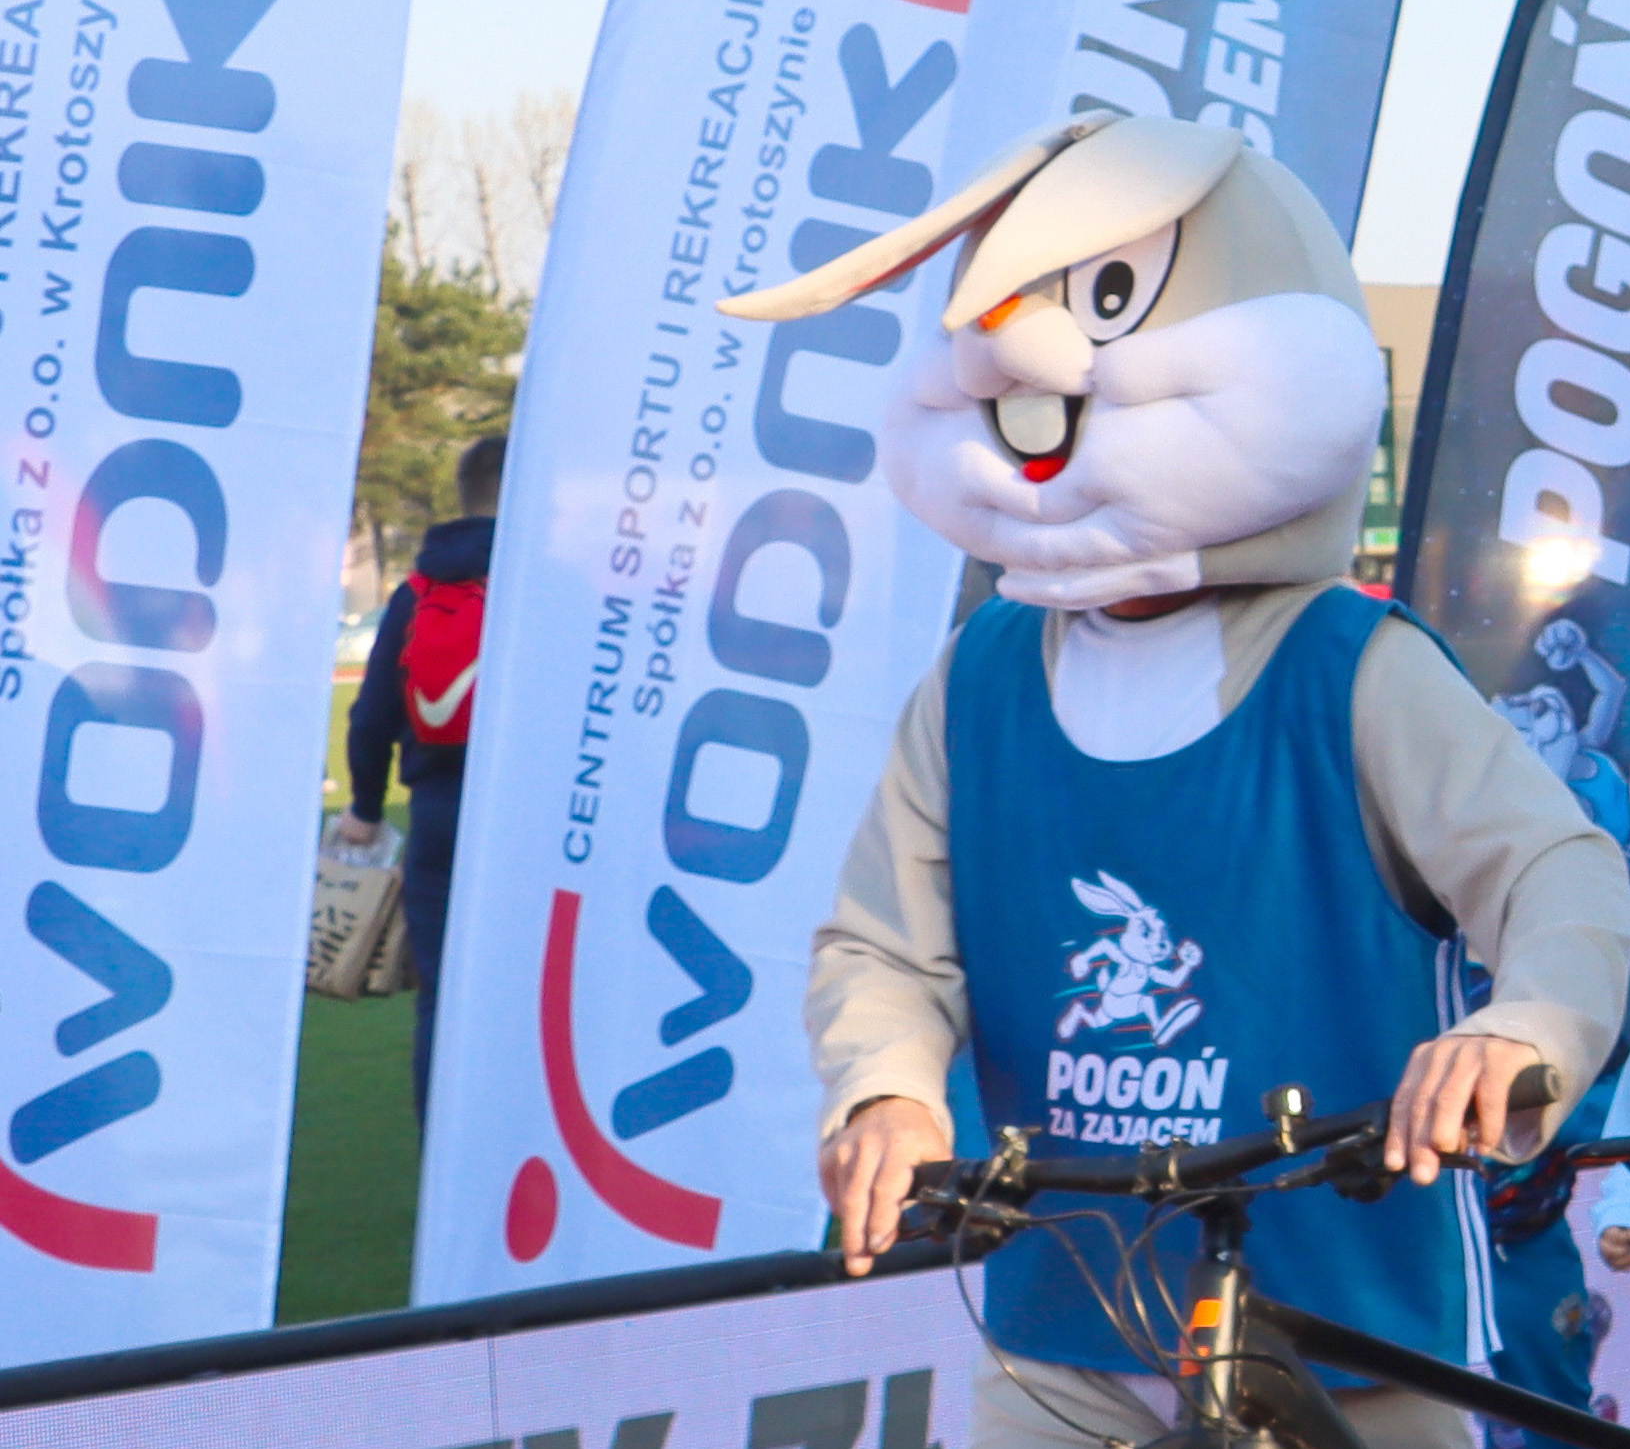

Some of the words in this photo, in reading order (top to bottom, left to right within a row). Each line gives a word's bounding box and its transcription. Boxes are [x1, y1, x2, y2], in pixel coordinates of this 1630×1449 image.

[691, 388, 732, 485] o.o.
[681, 501, 709, 540] z
[563, 595, 634, 866] CENTRUM
[611, 353, 682, 580] SPORTU
[633, 544, 697, 718] Spółka
[1046, 1046, 1229, 1111] POGOŃ
[1048, 1107, 1078, 1141] ZA
